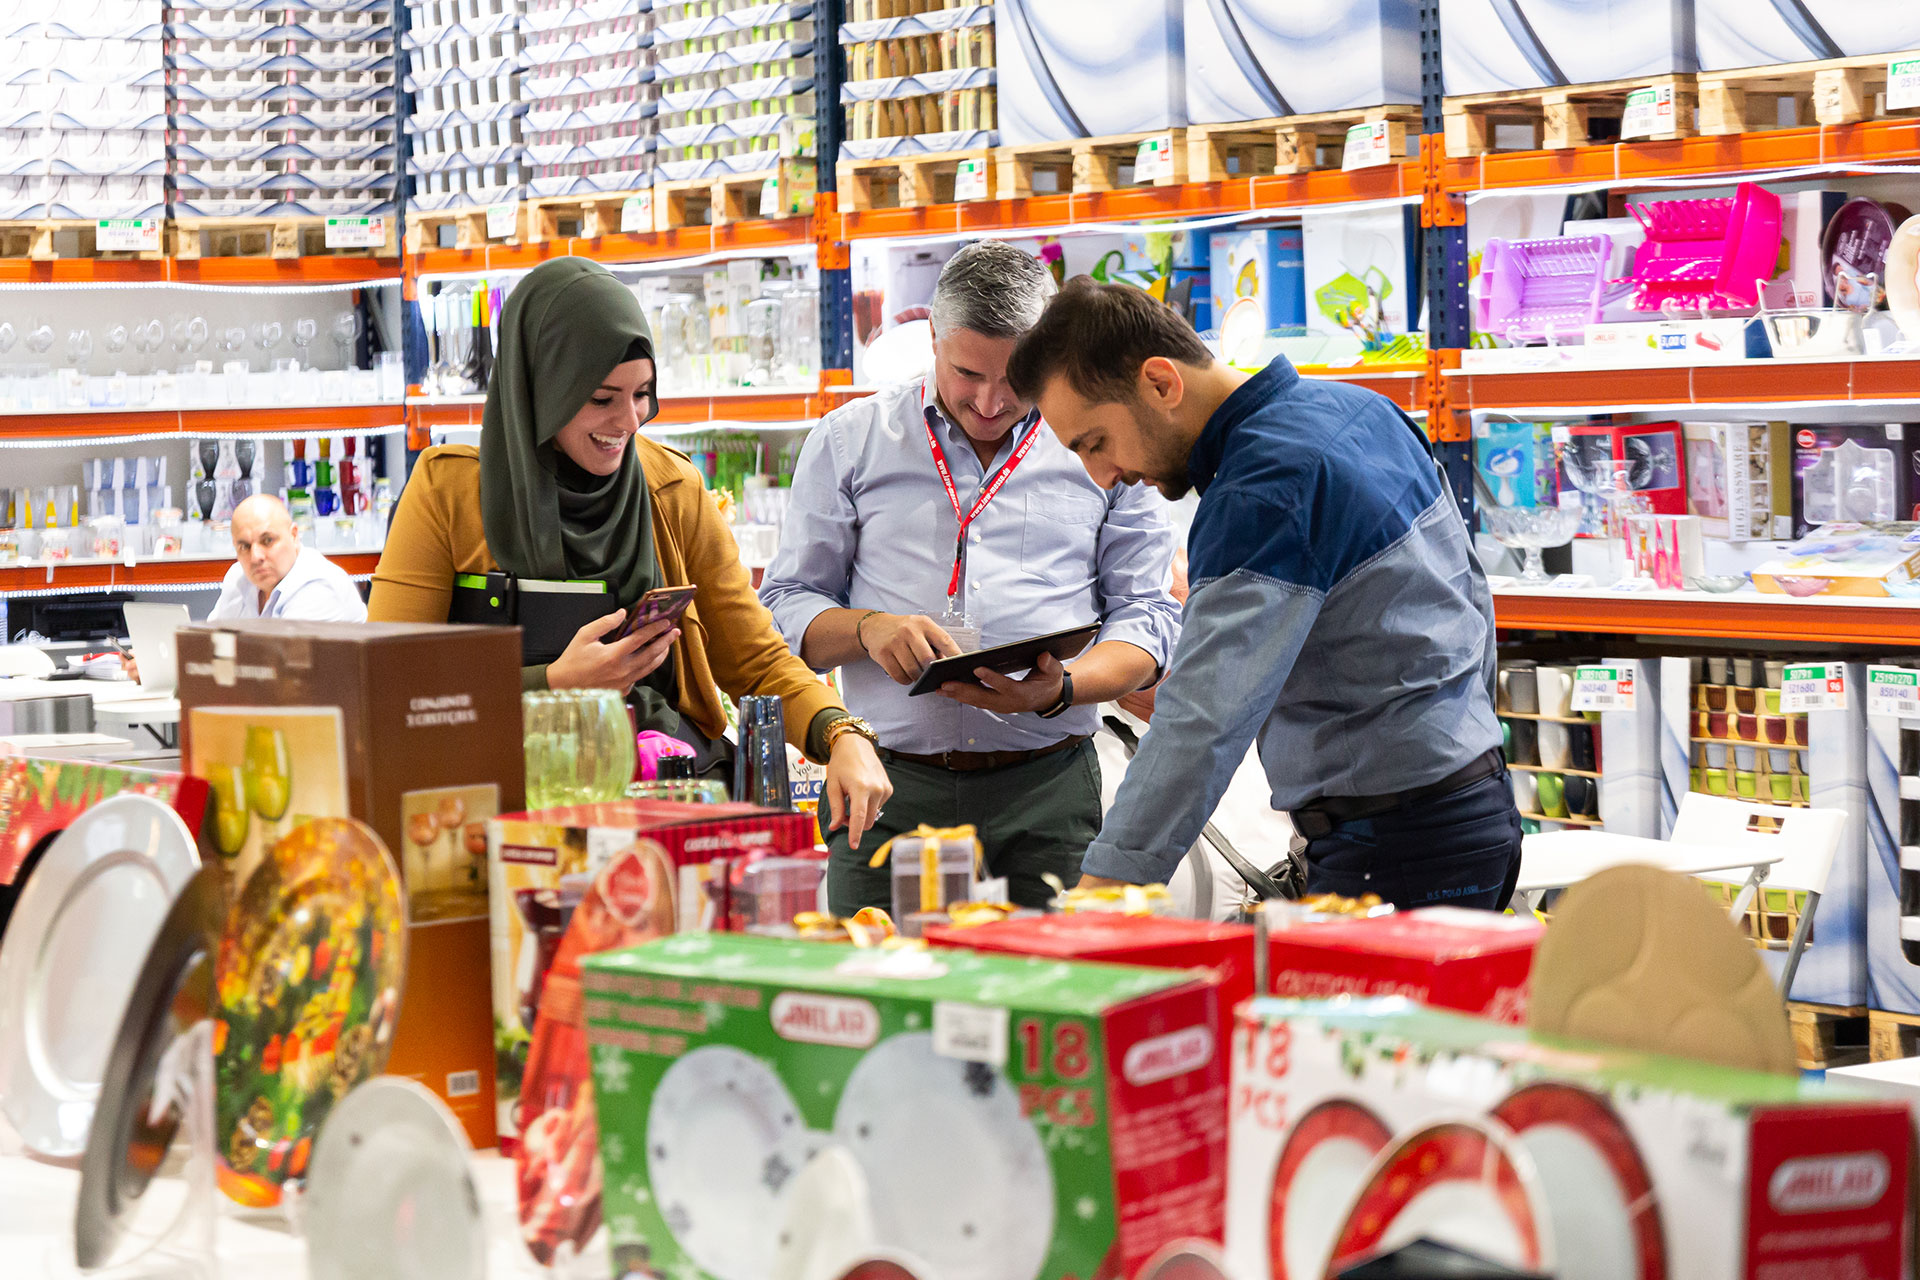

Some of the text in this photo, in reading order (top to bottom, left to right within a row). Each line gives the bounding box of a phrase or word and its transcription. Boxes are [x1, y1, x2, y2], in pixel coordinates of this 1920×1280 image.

[1733, 445, 1745, 520] GLASSWARE
[1829, 682, 1841, 691] 96
[796, 764, 812, 777] You
[1442, 888, 1461, 898] POLO
[1019, 1018, 1091, 1079] 18
[1241, 1020, 1292, 1079] 18
[1019, 1083, 1096, 1127] PCS
